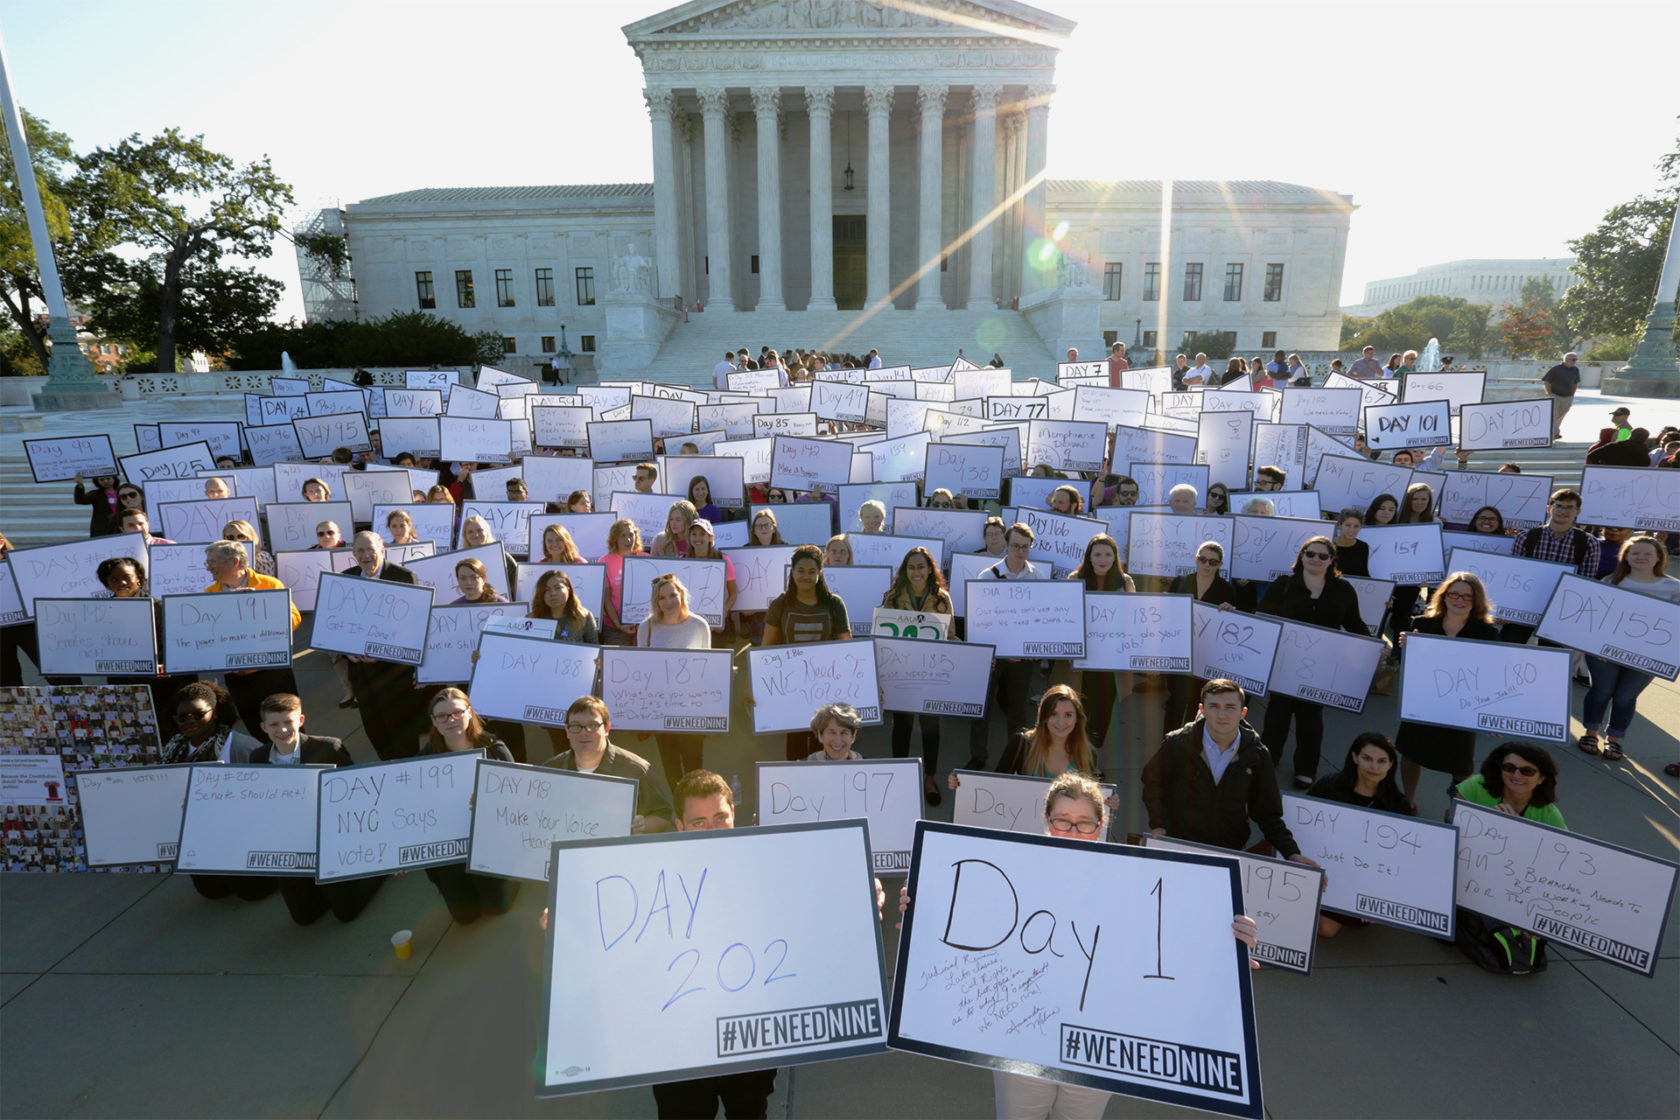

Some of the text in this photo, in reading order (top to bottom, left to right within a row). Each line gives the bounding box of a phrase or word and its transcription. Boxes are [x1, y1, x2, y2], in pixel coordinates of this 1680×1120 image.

[428, 373, 448, 384] 29
[1066, 365, 1090, 376] DAY
[264, 400, 287, 416] DAY
[393, 391, 415, 408] DAY
[1364, 390, 1388, 404] 67
[991, 403, 1046, 418] DAY 77
[334, 421, 360, 442] 95
[757, 418, 774, 428] Day
[1377, 414, 1413, 433] DAY
[1418, 413, 1438, 433] 101
[1468, 405, 1543, 442] DAY 100
[29, 439, 95, 459] Day 99
[1063, 447, 1072, 460] 9
[1407, 437, 1449, 447] #WENEEDNINE
[1503, 437, 1549, 447] #WENEEDNINE
[138, 461, 172, 480] Day
[937, 448, 991, 484] Day 138
[1346, 469, 1402, 502] 158
[165, 502, 227, 540] DAY
[1027, 512, 1048, 534] Day
[1193, 520, 1227, 545] 163
[27, 551, 80, 582] DAY
[1504, 573, 1536, 593] 156
[326, 579, 410, 622] DAY 190
[181, 596, 269, 635] Day 191
[325, 614, 364, 634] Get It
[1090, 605, 1118, 624] DAY
[1133, 606, 1164, 625] 183
[1559, 589, 1673, 647] DAY 155
[176, 636, 193, 648] The
[1140, 628, 1184, 643] do your
[1215, 620, 1263, 656] 182
[227, 653, 290, 667] #WENEEDNINE
[366, 643, 422, 662] #WENEEDNINE
[881, 646, 956, 674] DAY 185
[1025, 642, 1084, 655] #WENEEDNINE
[97, 661, 154, 673] #WENEEDNINE
[502, 652, 583, 679] DAY 188
[1131, 656, 1190, 670] #WENEEDNINE
[1602, 644, 1676, 677] #WENEEDNINE
[610, 657, 709, 692] Day 187
[1432, 662, 1538, 699] DAY 180
[612, 690, 643, 699] What
[668, 692, 684, 702] you
[1299, 686, 1362, 710] #WENEEDNINE
[1459, 698, 1472, 711] Do
[525, 707, 566, 723] #WENEED
[924, 701, 983, 716] #WENEEDNINE
[665, 717, 728, 730] #WENEEDNINE
[1480, 715, 1564, 740] #WENEEDNINE
[194, 788, 236, 801] Senate
[323, 763, 457, 808] DAY #199
[484, 770, 554, 802] DAY 198
[770, 769, 896, 822] Day 197
[971, 786, 1024, 830] Day
[337, 806, 439, 835] NYC Says
[495, 806, 601, 839] Make Your Voice
[1295, 804, 1424, 857] DAY 194
[249, 852, 319, 869] #WENEEDNIN
[336, 842, 389, 867] vote!
[400, 840, 469, 863] #WENEEDN
[1352, 856, 1371, 869] Do
[1531, 837, 1599, 878] 193
[1503, 858, 1517, 877] 3
[1246, 862, 1308, 904] 195
[594, 865, 709, 953] DAY
[1255, 909, 1282, 926] say
[1358, 896, 1450, 934] #WENEEDNINE
[938, 858, 1176, 1014] Day 1
[1535, 916, 1649, 967] #WENEEDNINE
[659, 938, 798, 1013] 202
[993, 1000, 1019, 1023] NEED
[722, 1003, 881, 1053] #WENEEDNINE
[1064, 1029, 1242, 1092] #WENEEDNINE
